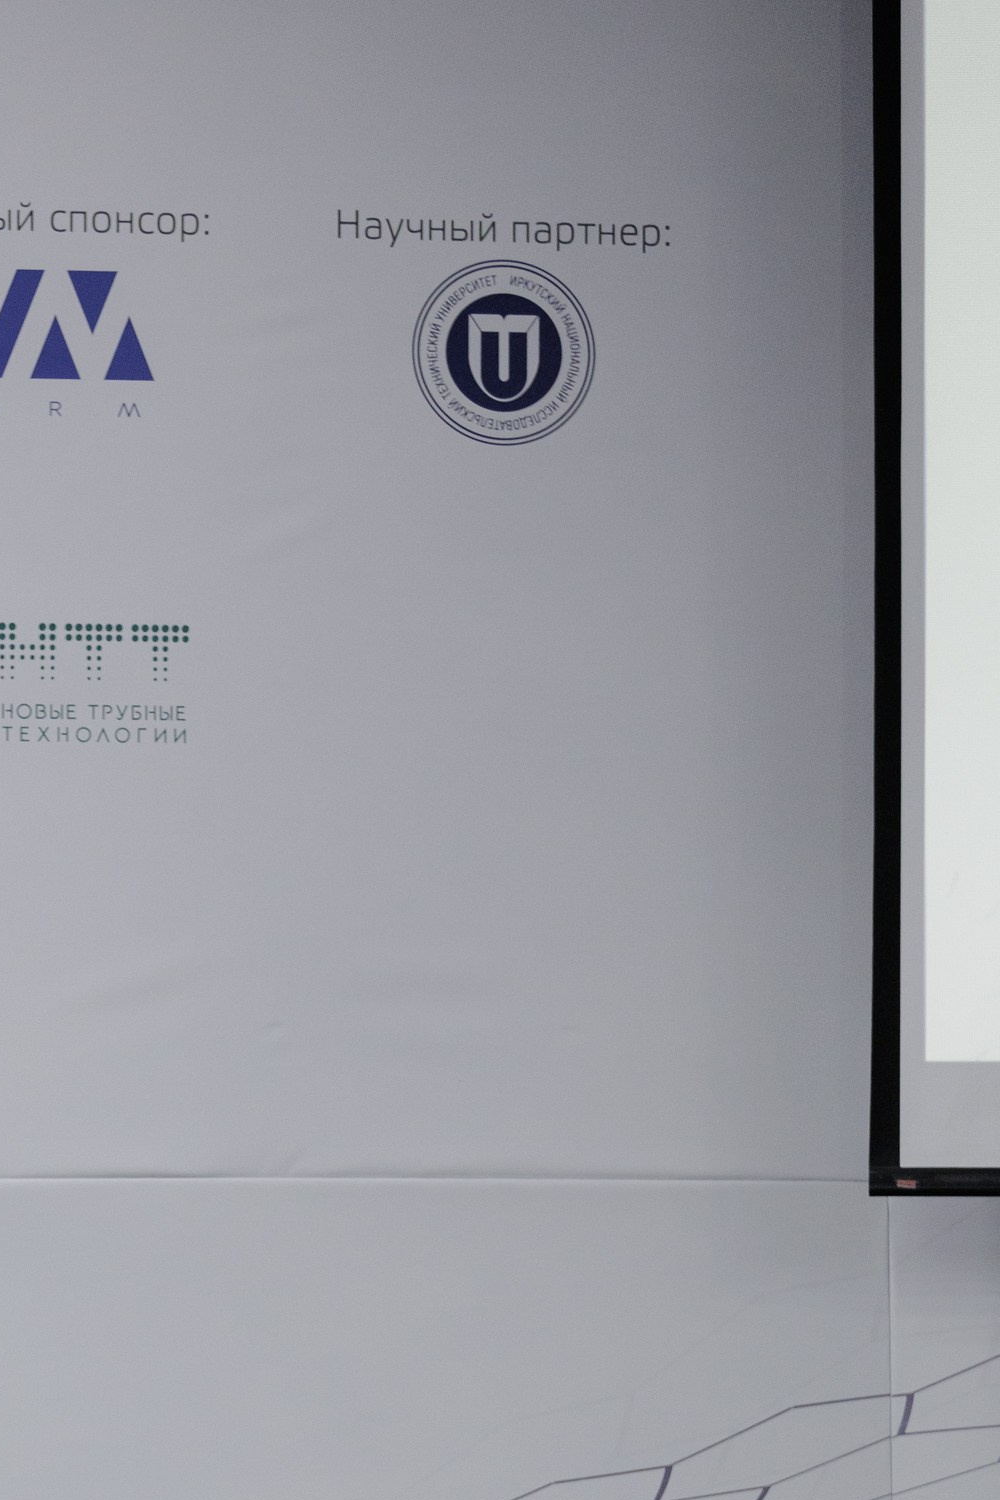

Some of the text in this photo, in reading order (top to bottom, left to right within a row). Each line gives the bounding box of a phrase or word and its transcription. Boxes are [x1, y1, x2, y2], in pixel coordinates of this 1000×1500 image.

[50, 208, 211, 241] спонсор:
[336, 209, 671, 253] Научный партнер:
[435, 274, 498, 323] УНИВЕРСИТЕТ
[509, 274, 567, 318] ИРКУТСКИЙ
[426, 322, 452, 403] ТЕХНИЧЕСКИЙ
[561, 313, 582, 406] НАЦИОНАЛЬНЫЙ
[1, 703, 186, 721] НОВЫЕ ТРУБНЫЕ
[2, 726, 187, 744] ТЕХНОЛОГИИ
